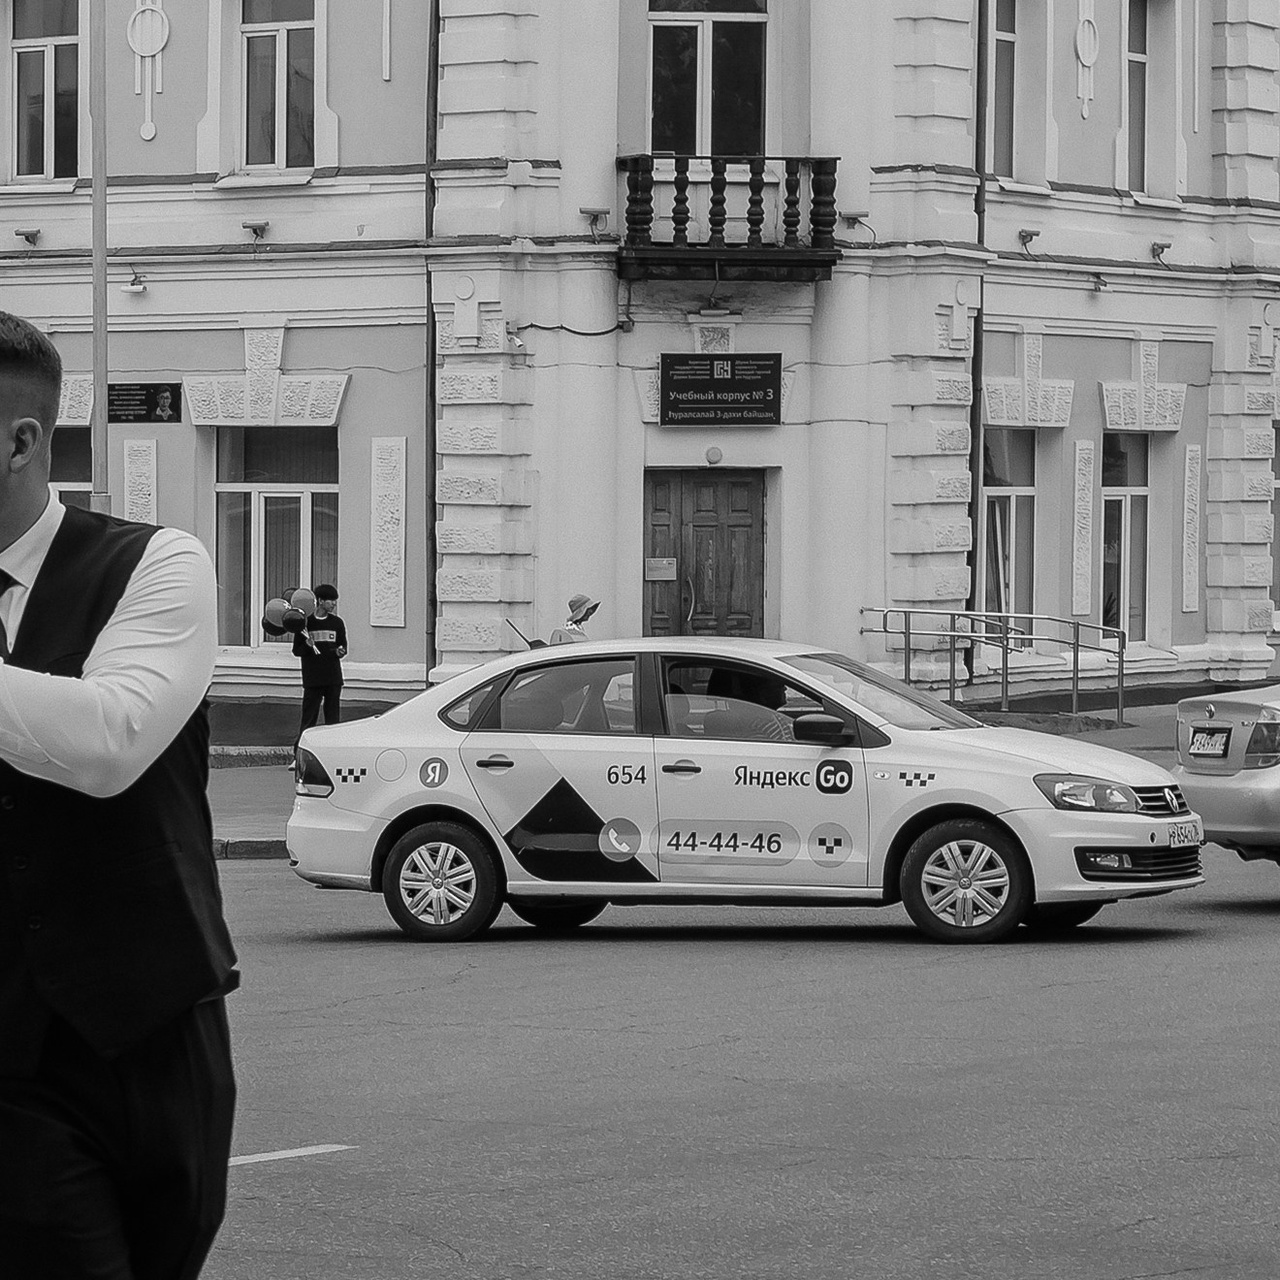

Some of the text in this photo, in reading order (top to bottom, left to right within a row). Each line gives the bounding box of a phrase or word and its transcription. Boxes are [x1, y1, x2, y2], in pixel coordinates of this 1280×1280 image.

[669, 389, 774, 402] Учебный корпус № 3
[426, 762, 441, 783] Я
[607, 765, 647, 785] 654
[734, 765, 850, 789] Яндекс Go
[666, 831, 782, 854] 44-44-46
